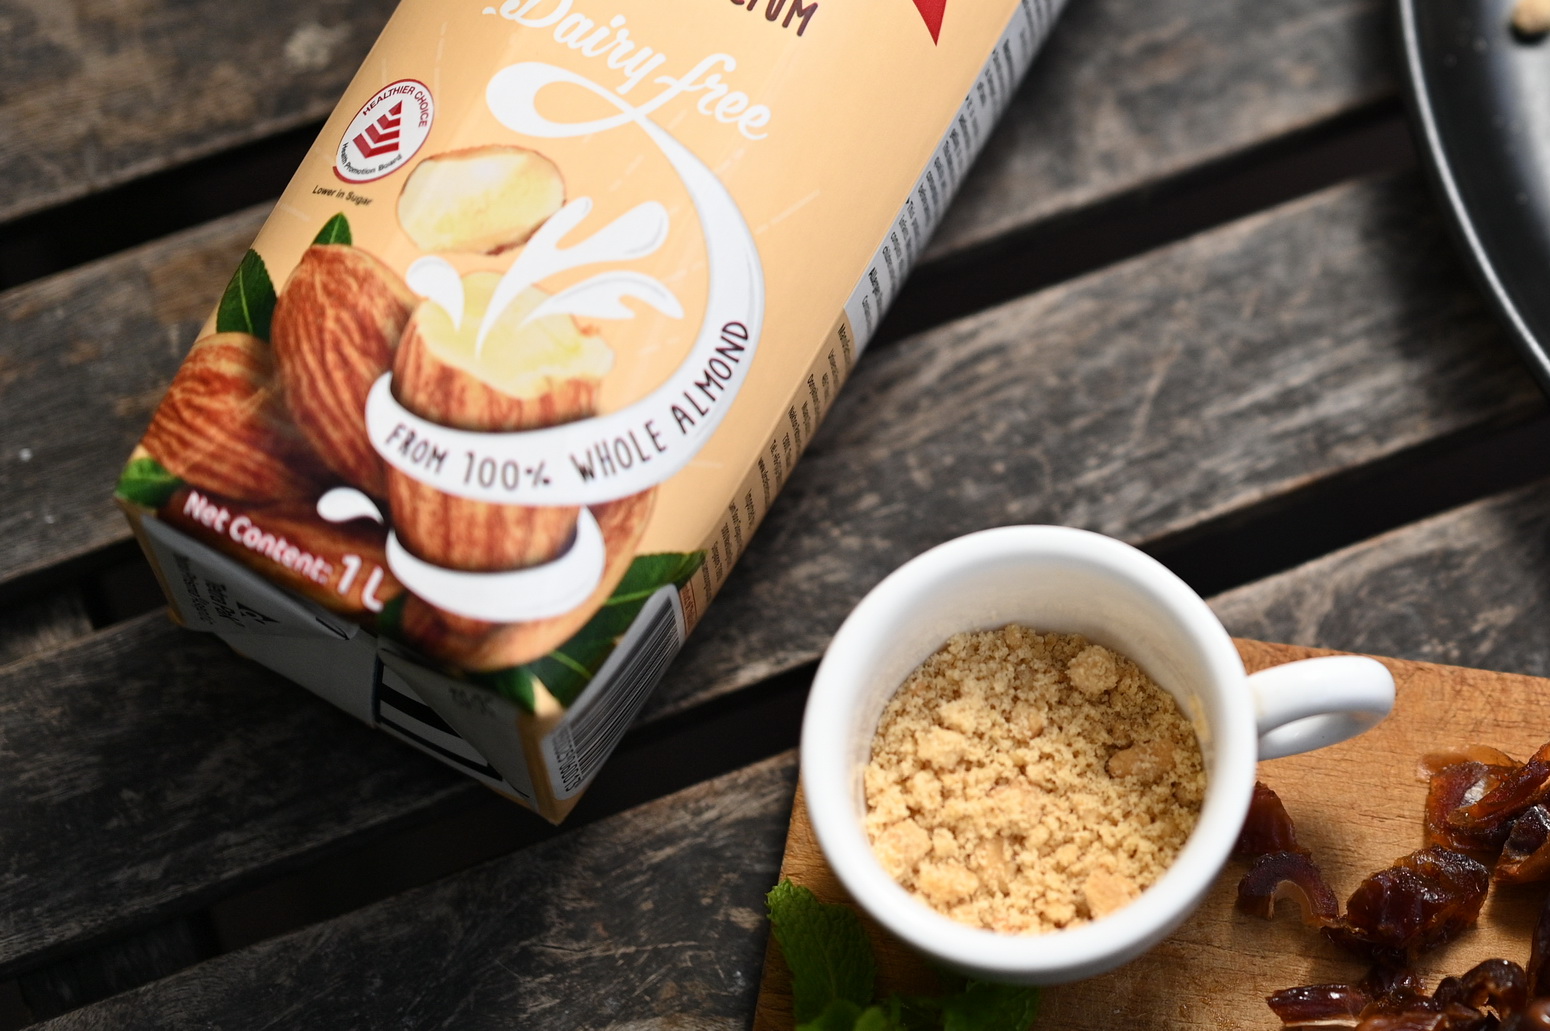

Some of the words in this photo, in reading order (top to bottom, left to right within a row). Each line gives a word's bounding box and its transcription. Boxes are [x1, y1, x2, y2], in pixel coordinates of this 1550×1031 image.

[362, 85, 415, 116] HEALTHIER
[414, 90, 430, 128] CHOICE
[653, 53, 771, 140] free
[312, 184, 336, 198] Lower
[385, 423, 448, 475] FROM
[463, 452, 550, 491] 100%
[570, 419, 667, 485] WHOLE
[669, 321, 749, 435] ALMOND
[183, 490, 230, 533] Net
